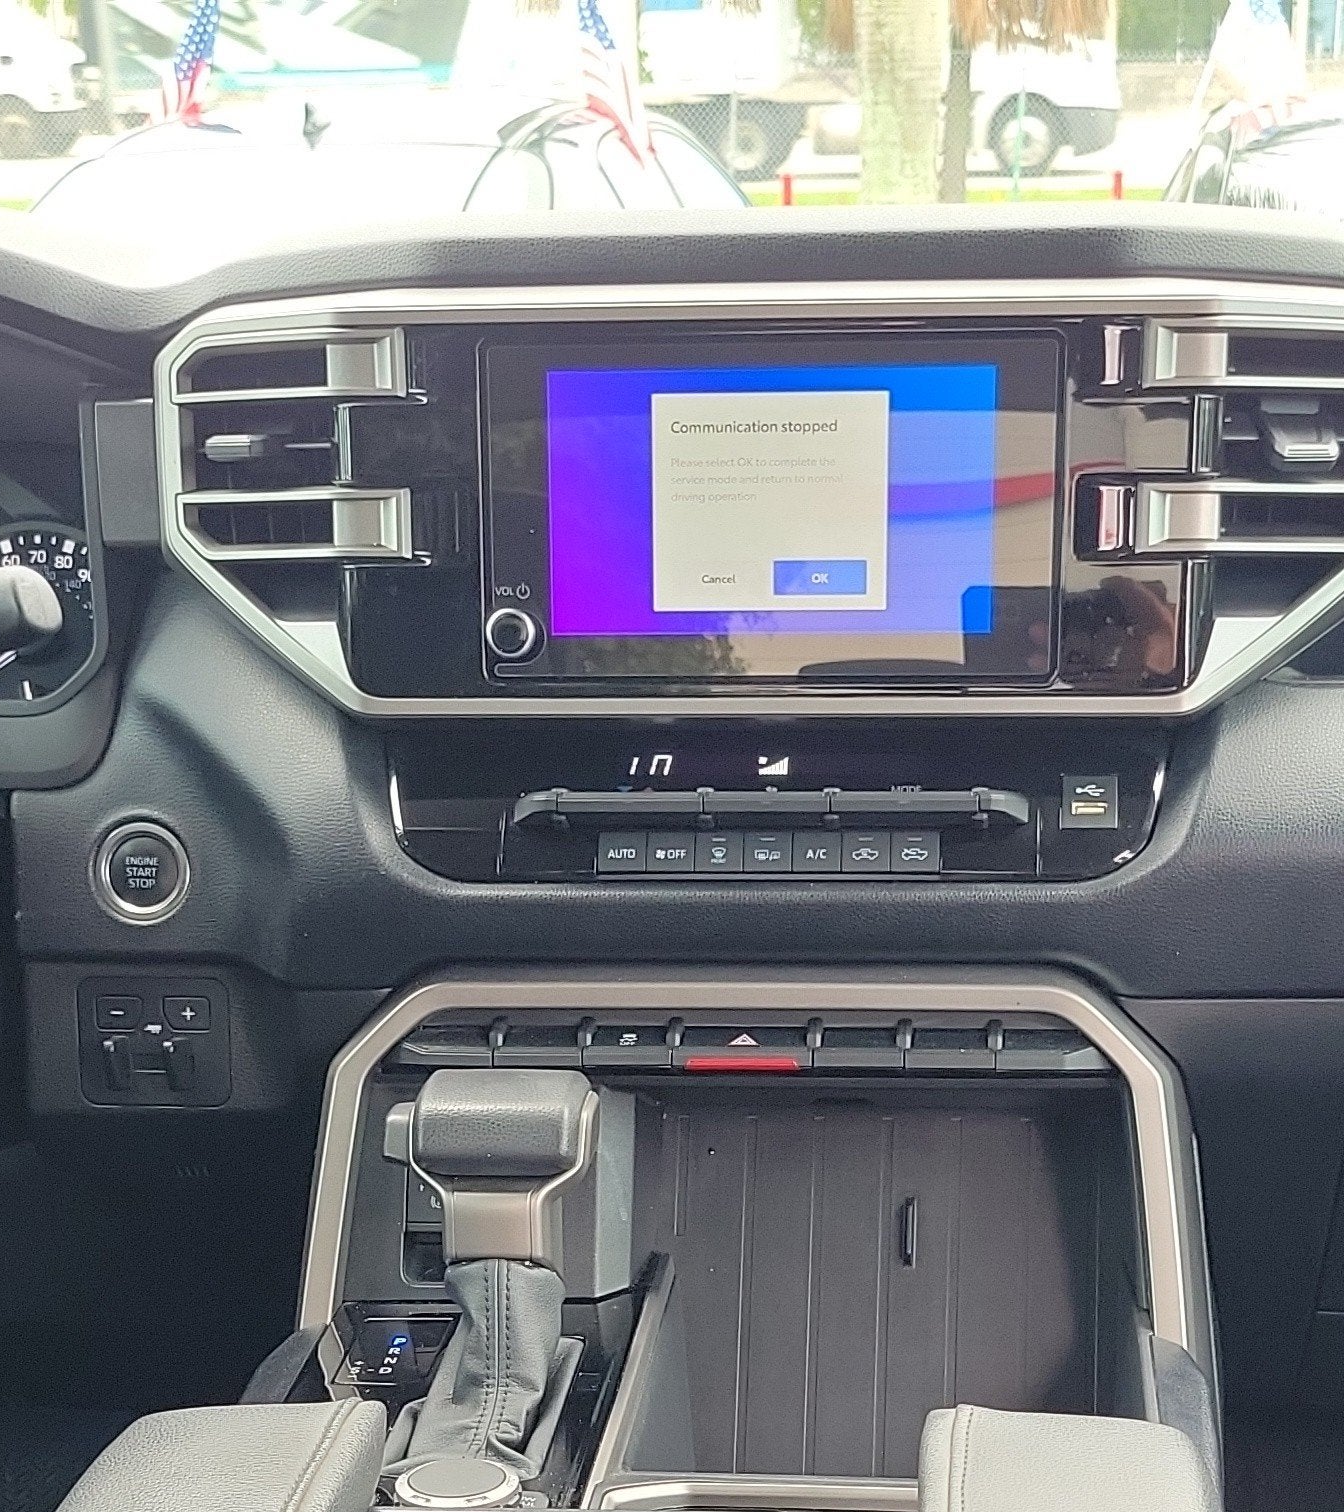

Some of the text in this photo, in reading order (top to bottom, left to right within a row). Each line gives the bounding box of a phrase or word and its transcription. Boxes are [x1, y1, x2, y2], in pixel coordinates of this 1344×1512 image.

[670, 419, 838, 435] Communication stopped
[670, 457, 704, 468] Please
[705, 457, 735, 467] select
[736, 457, 754, 467] OK
[755, 458, 767, 467] to
[768, 456, 817, 469] complete
[707, 475, 738, 485] mode
[739, 474, 759, 484] and
[760, 475, 793, 484] return
[2, 554, 21, 567] 60
[28, 549, 47, 564] 70
[54, 555, 74, 569] 80
[701, 573, 736, 584] Cancel
[811, 573, 829, 584] OK
[494, 587, 515, 597] VOL
[607, 847, 636, 859] AUTO
[666, 848, 687, 860] OFF
[806, 848, 827, 860] A/C
[125, 856, 160, 866] ENGINE
[126, 867, 157, 878] START
[128, 878, 156, 889] STOP
